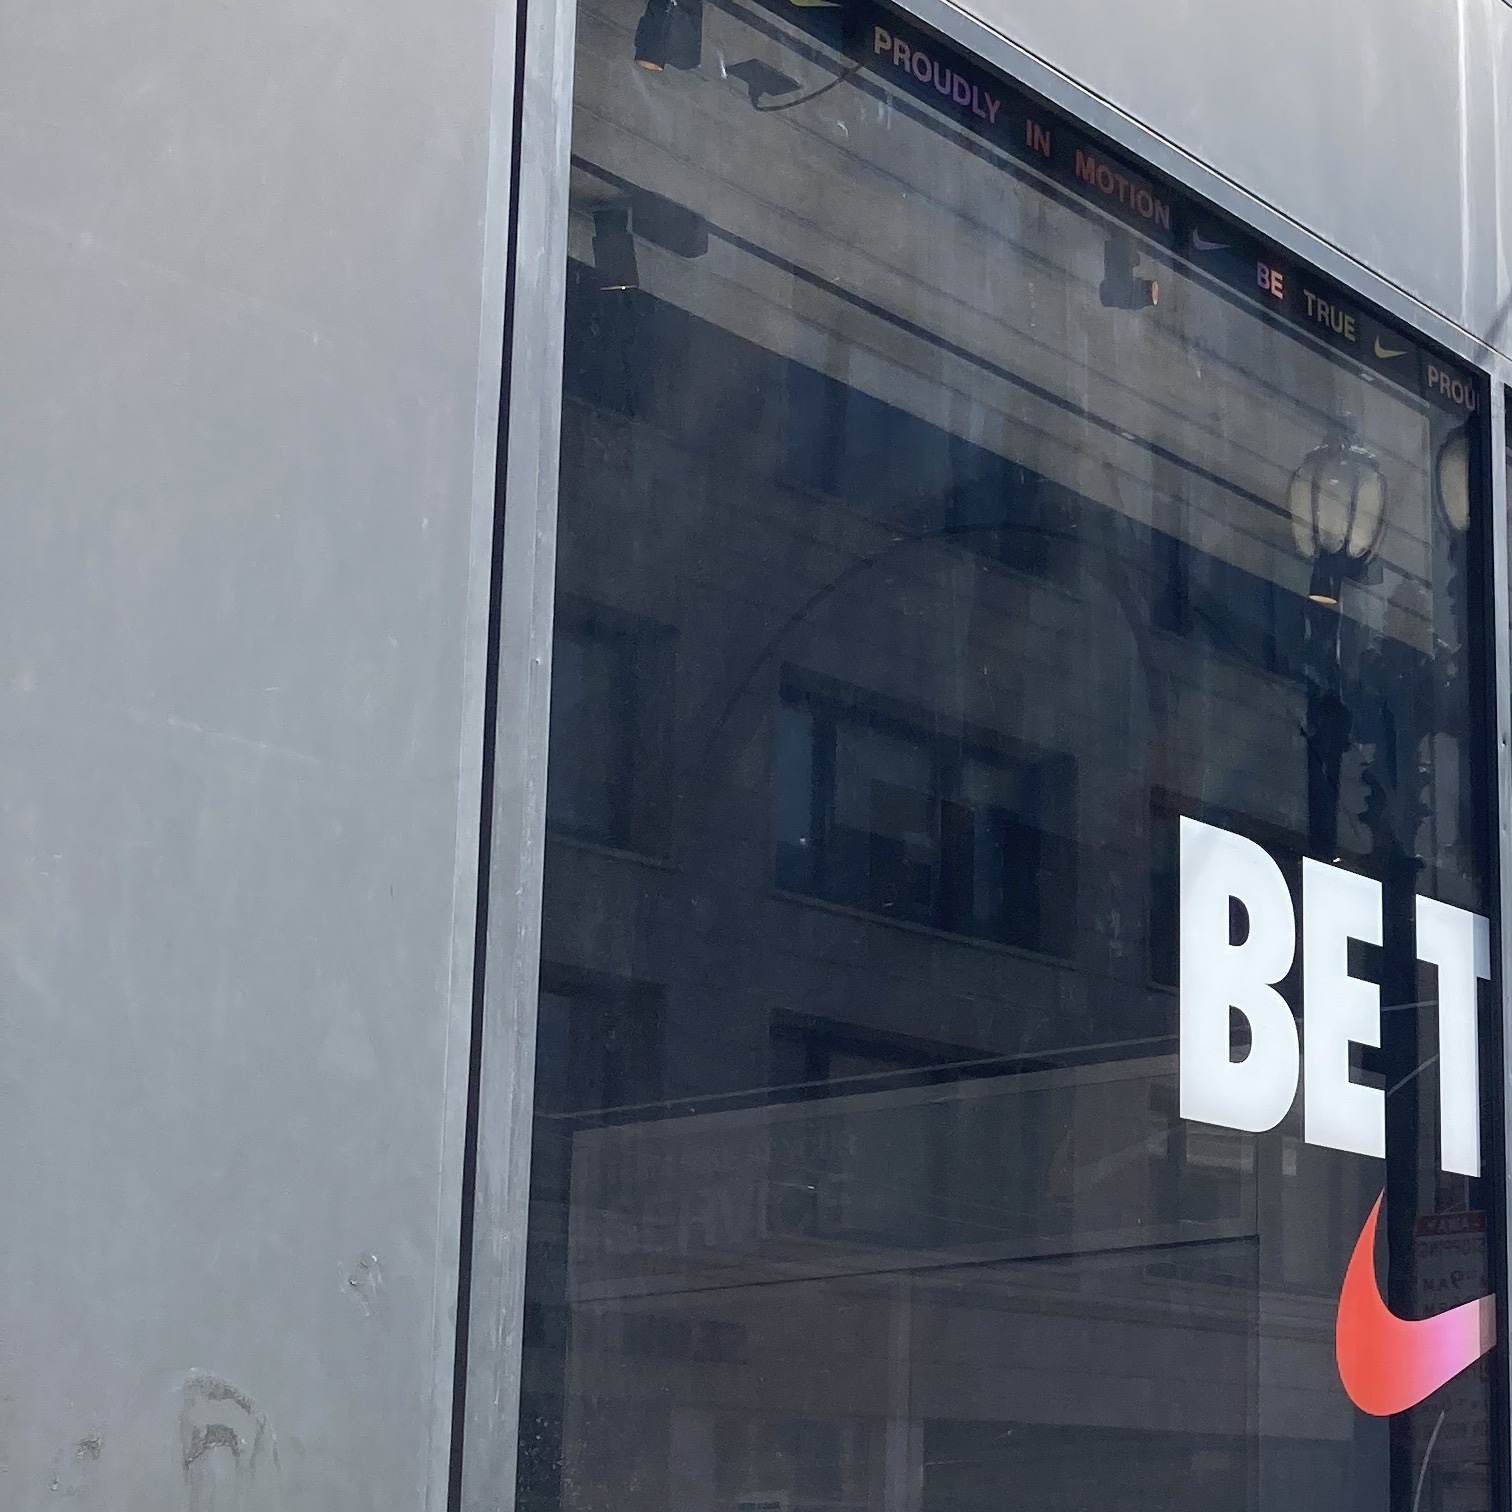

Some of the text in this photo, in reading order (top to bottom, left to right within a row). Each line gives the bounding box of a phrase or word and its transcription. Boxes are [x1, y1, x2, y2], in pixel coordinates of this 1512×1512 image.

[874, 26, 1170, 231] PROUDLY IN MOTION
[1256, 260, 1356, 342] BE TRUE
[1427, 365, 1480, 414] PROU
[1179, 815, 1386, 1159] BE
